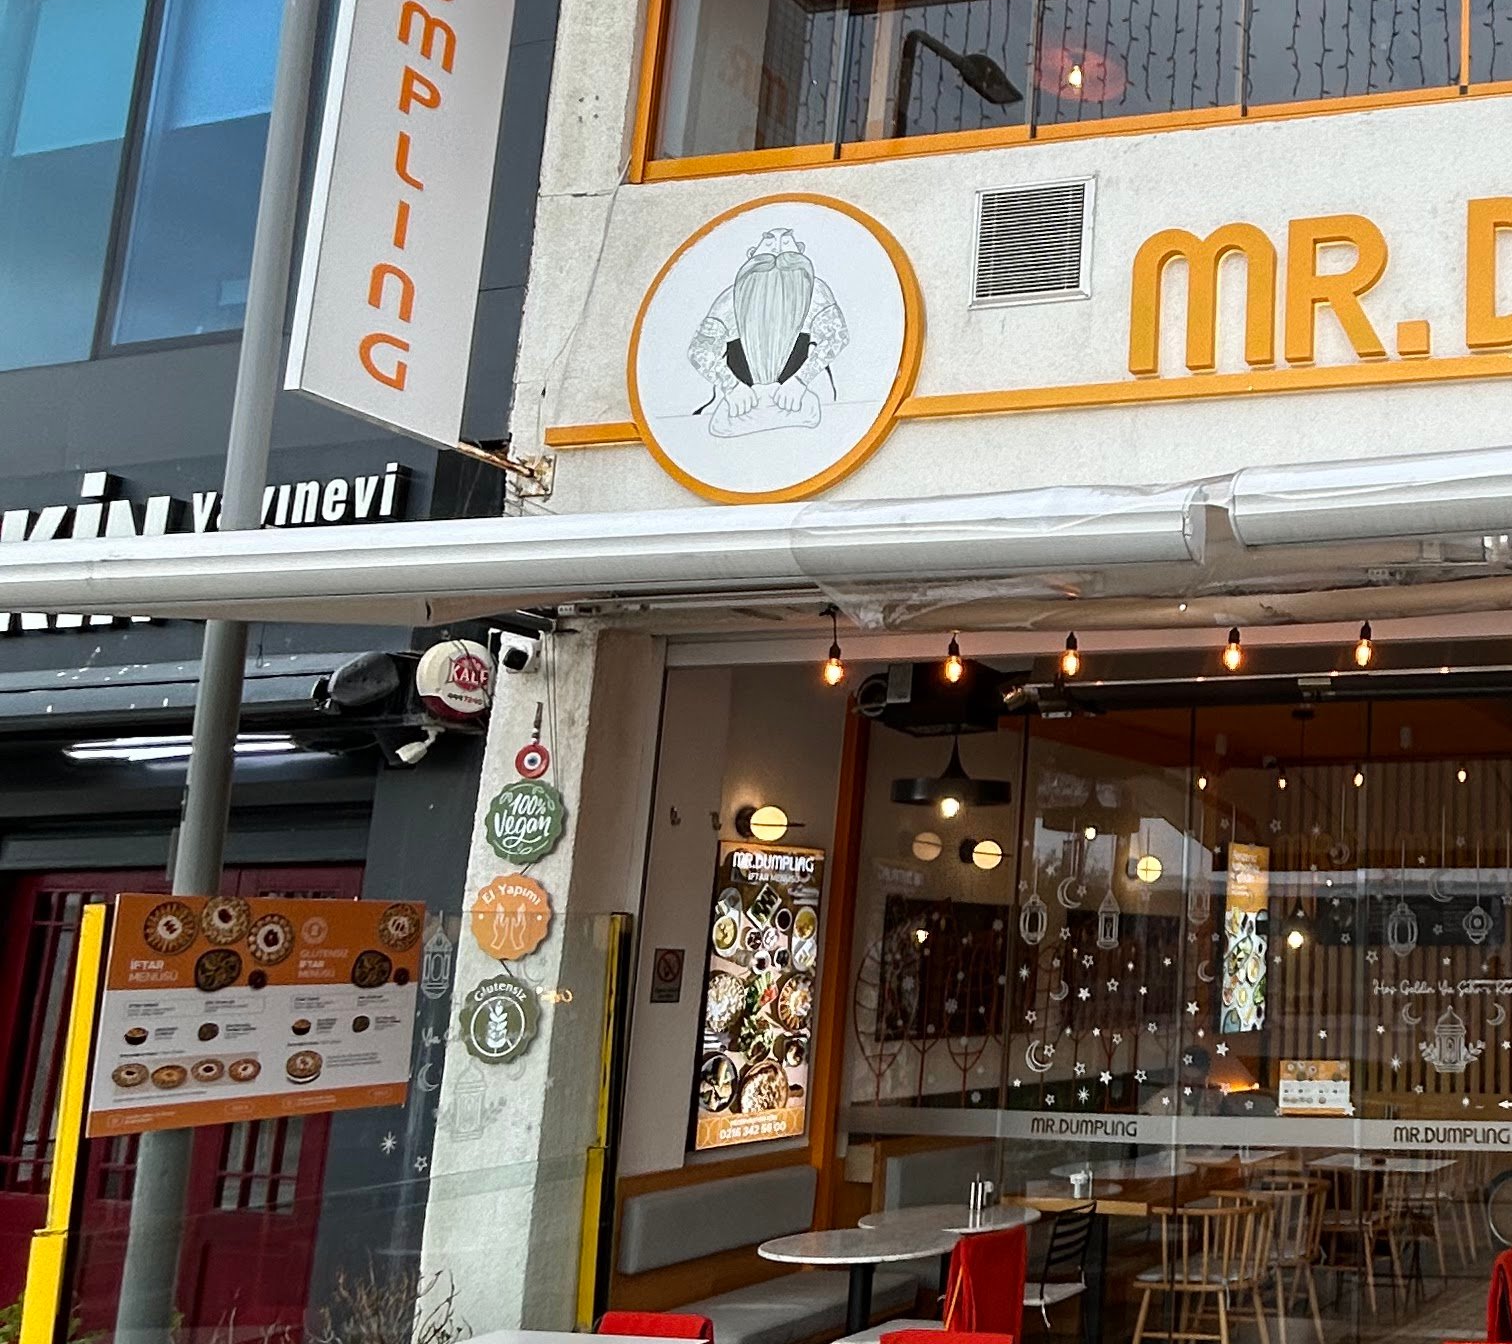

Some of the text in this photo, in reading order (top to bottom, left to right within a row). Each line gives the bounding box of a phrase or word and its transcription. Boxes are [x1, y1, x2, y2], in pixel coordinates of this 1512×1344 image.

[511, 792, 546, 816] 100%
[494, 809, 551, 848] Vegan
[482, 884, 541, 906] El Yapımı
[473, 983, 528, 1003] Glutensiz
[1030, 1117, 1138, 1137] MR.DUMPLING
[1393, 1125, 1511, 1145] MR.DUMPLING
